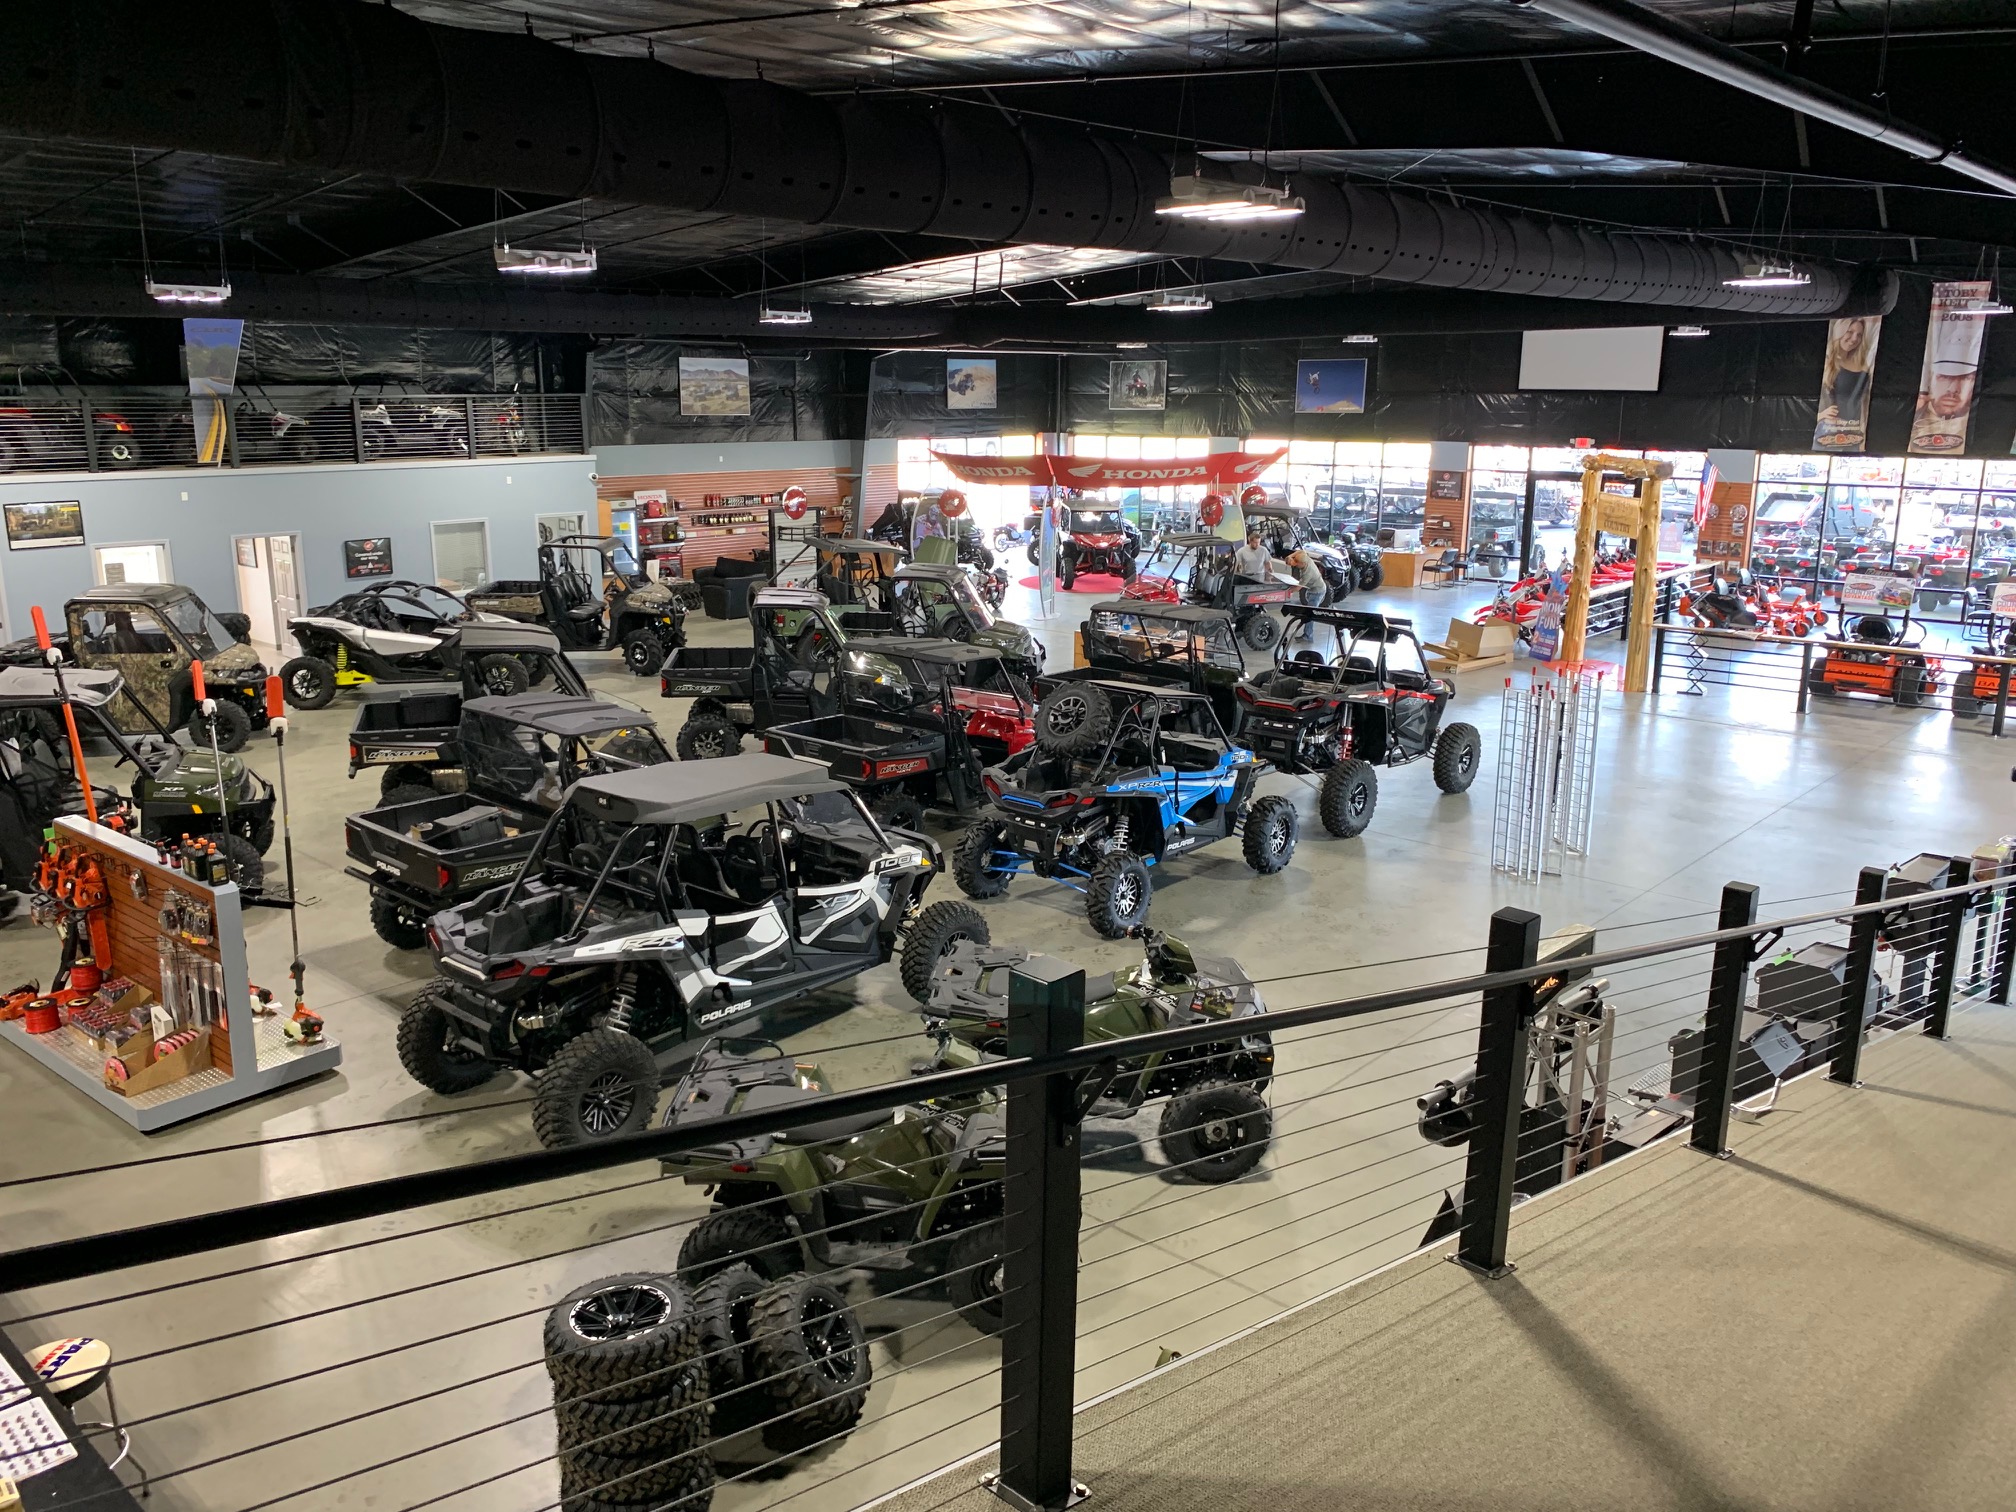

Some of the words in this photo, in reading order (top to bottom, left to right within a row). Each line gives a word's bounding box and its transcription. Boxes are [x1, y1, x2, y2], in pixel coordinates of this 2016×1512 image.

[1944, 288, 1978, 297] TOBY
[1941, 312, 1974, 322] 2008
[1102, 466, 1208, 479] HONDA
[1541, 602, 1562, 614] MOW
[1538, 616, 1560, 630] FUN!
[368, 750, 429, 759] RANGER
[880, 760, 920, 774] RANGER
[1167, 837, 1196, 851] POLARIS
[376, 860, 401, 876] POLARIS
[809, 895, 850, 910] XP
[621, 935, 683, 951] RZR
[701, 998, 752, 1024] POLARIS
